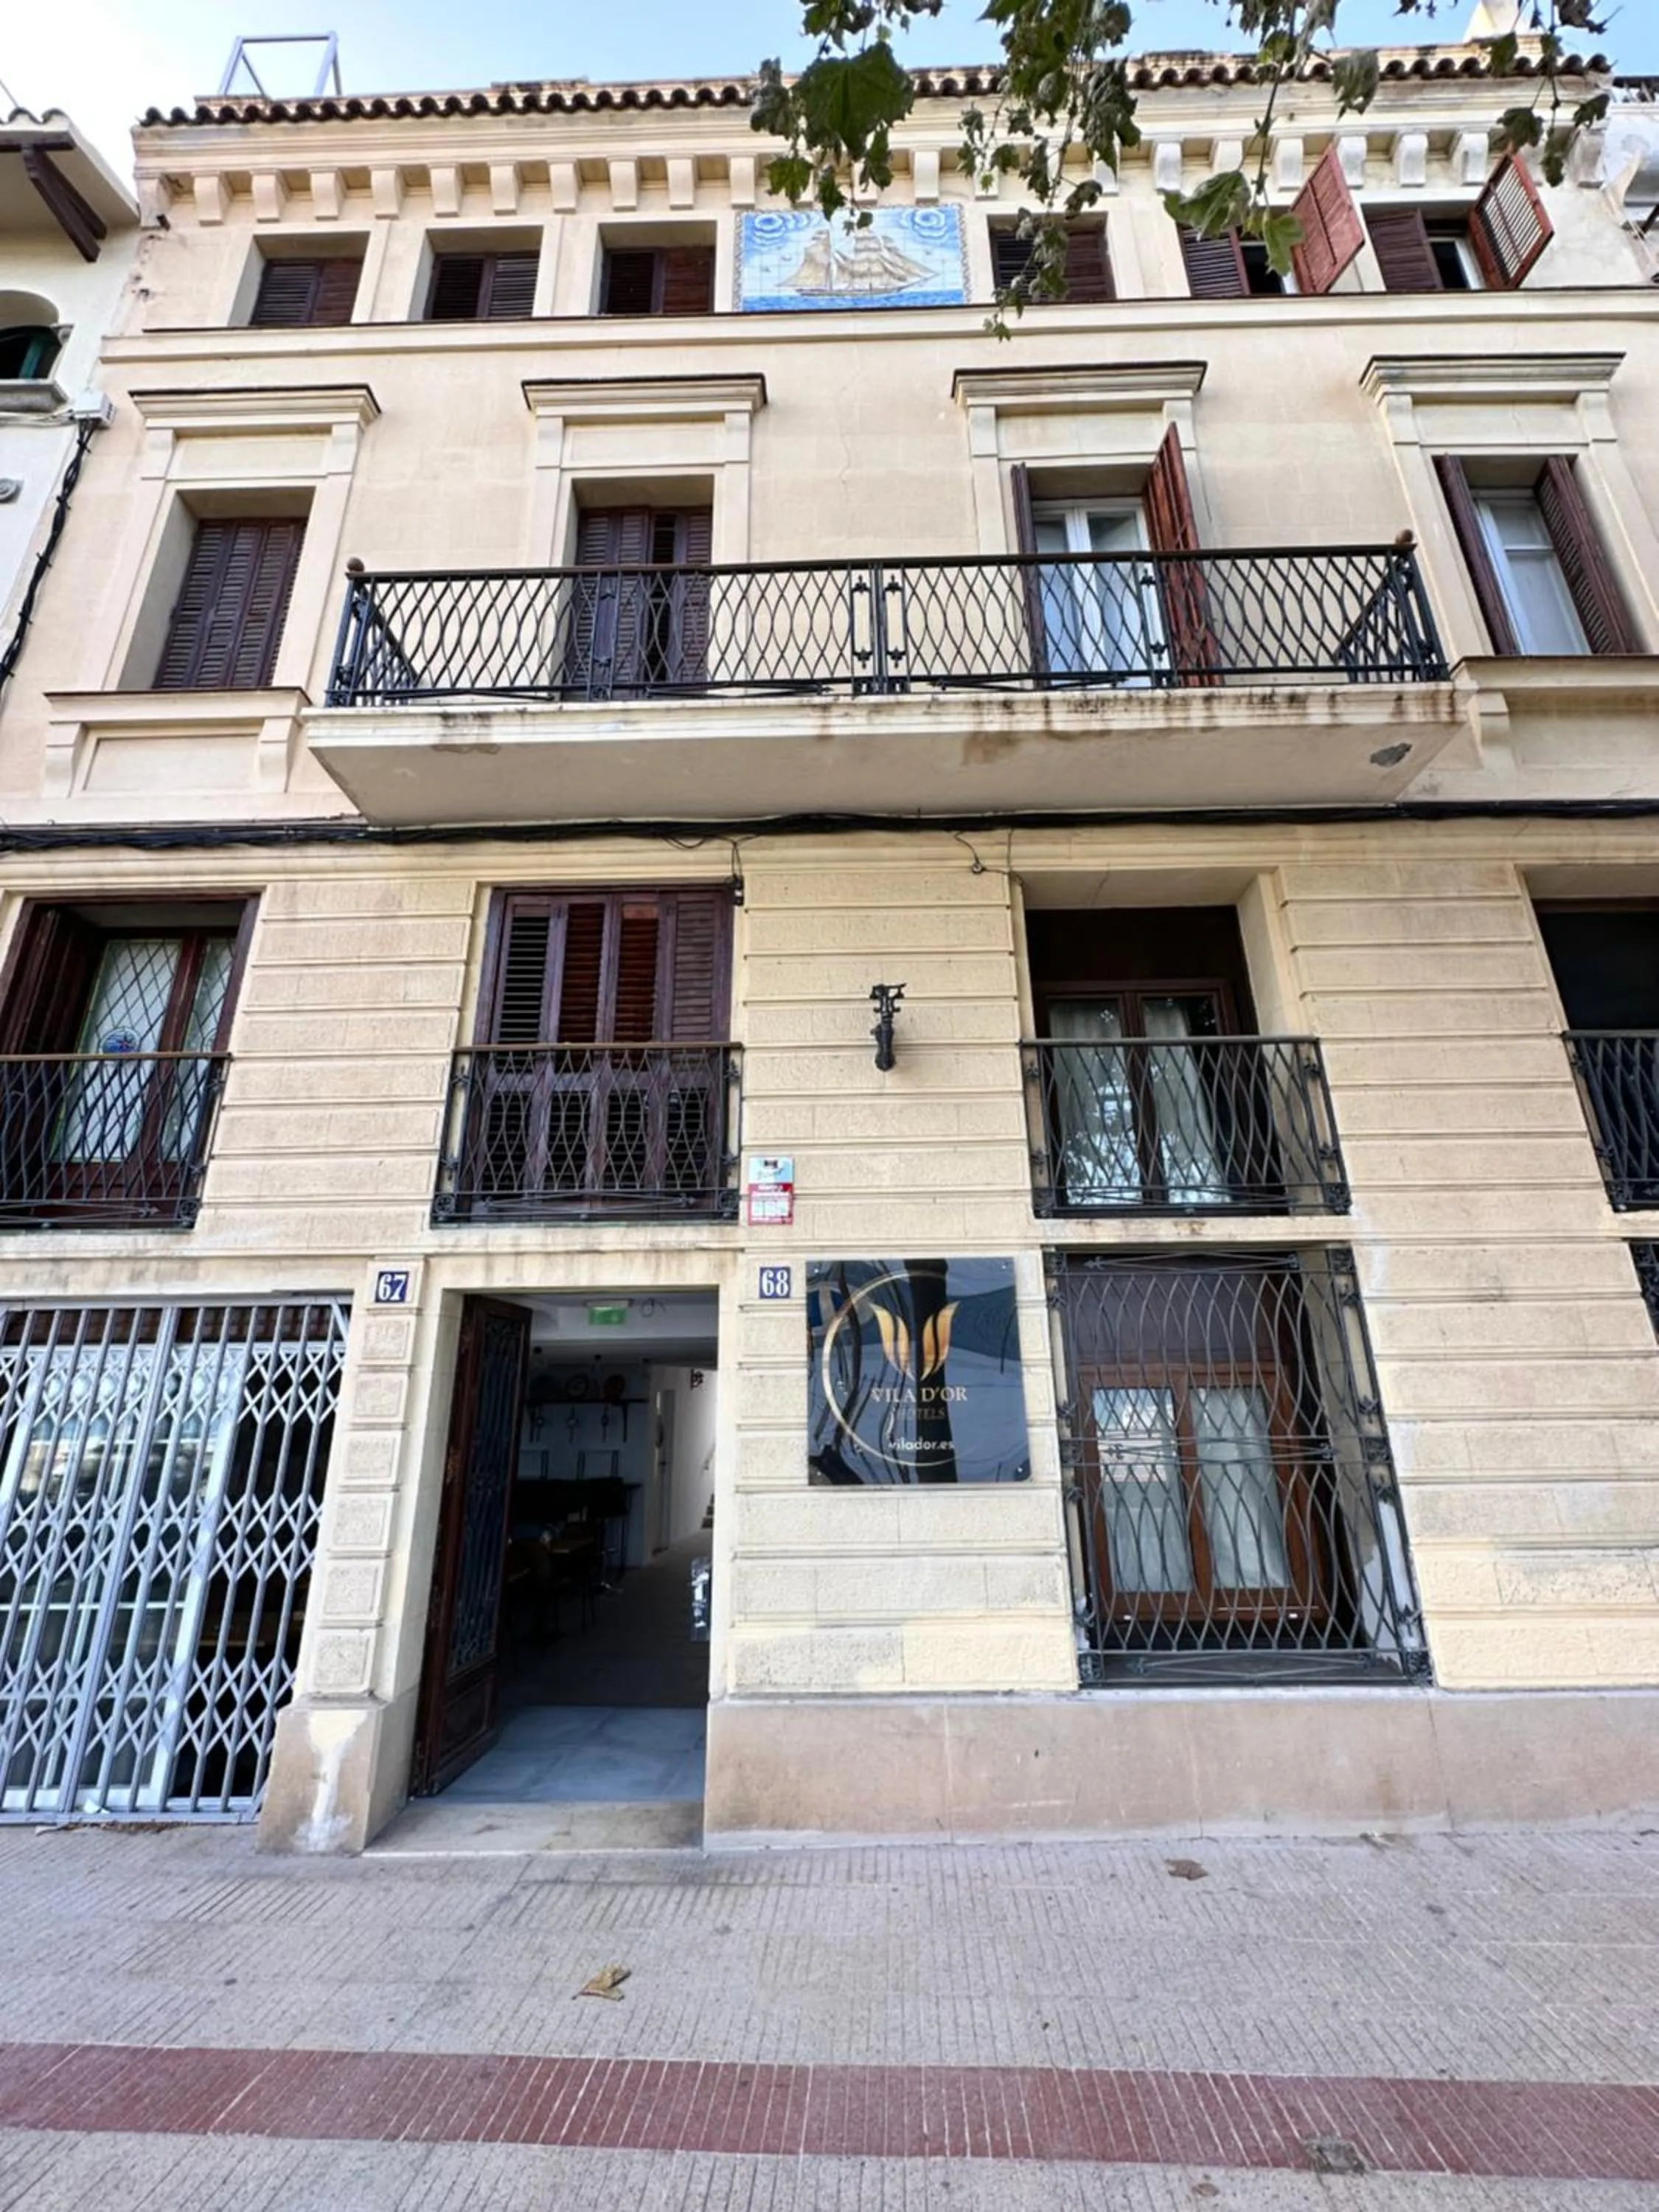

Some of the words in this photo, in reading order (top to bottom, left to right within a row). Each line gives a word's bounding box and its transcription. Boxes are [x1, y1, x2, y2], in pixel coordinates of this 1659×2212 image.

[378, 1273, 407, 1301] 67
[762, 1270, 789, 1296] 68
[871, 1387, 917, 1402] VILA
[921, 1386, 968, 1402] D'OR
[888, 1437, 955, 1450] vilador.es
